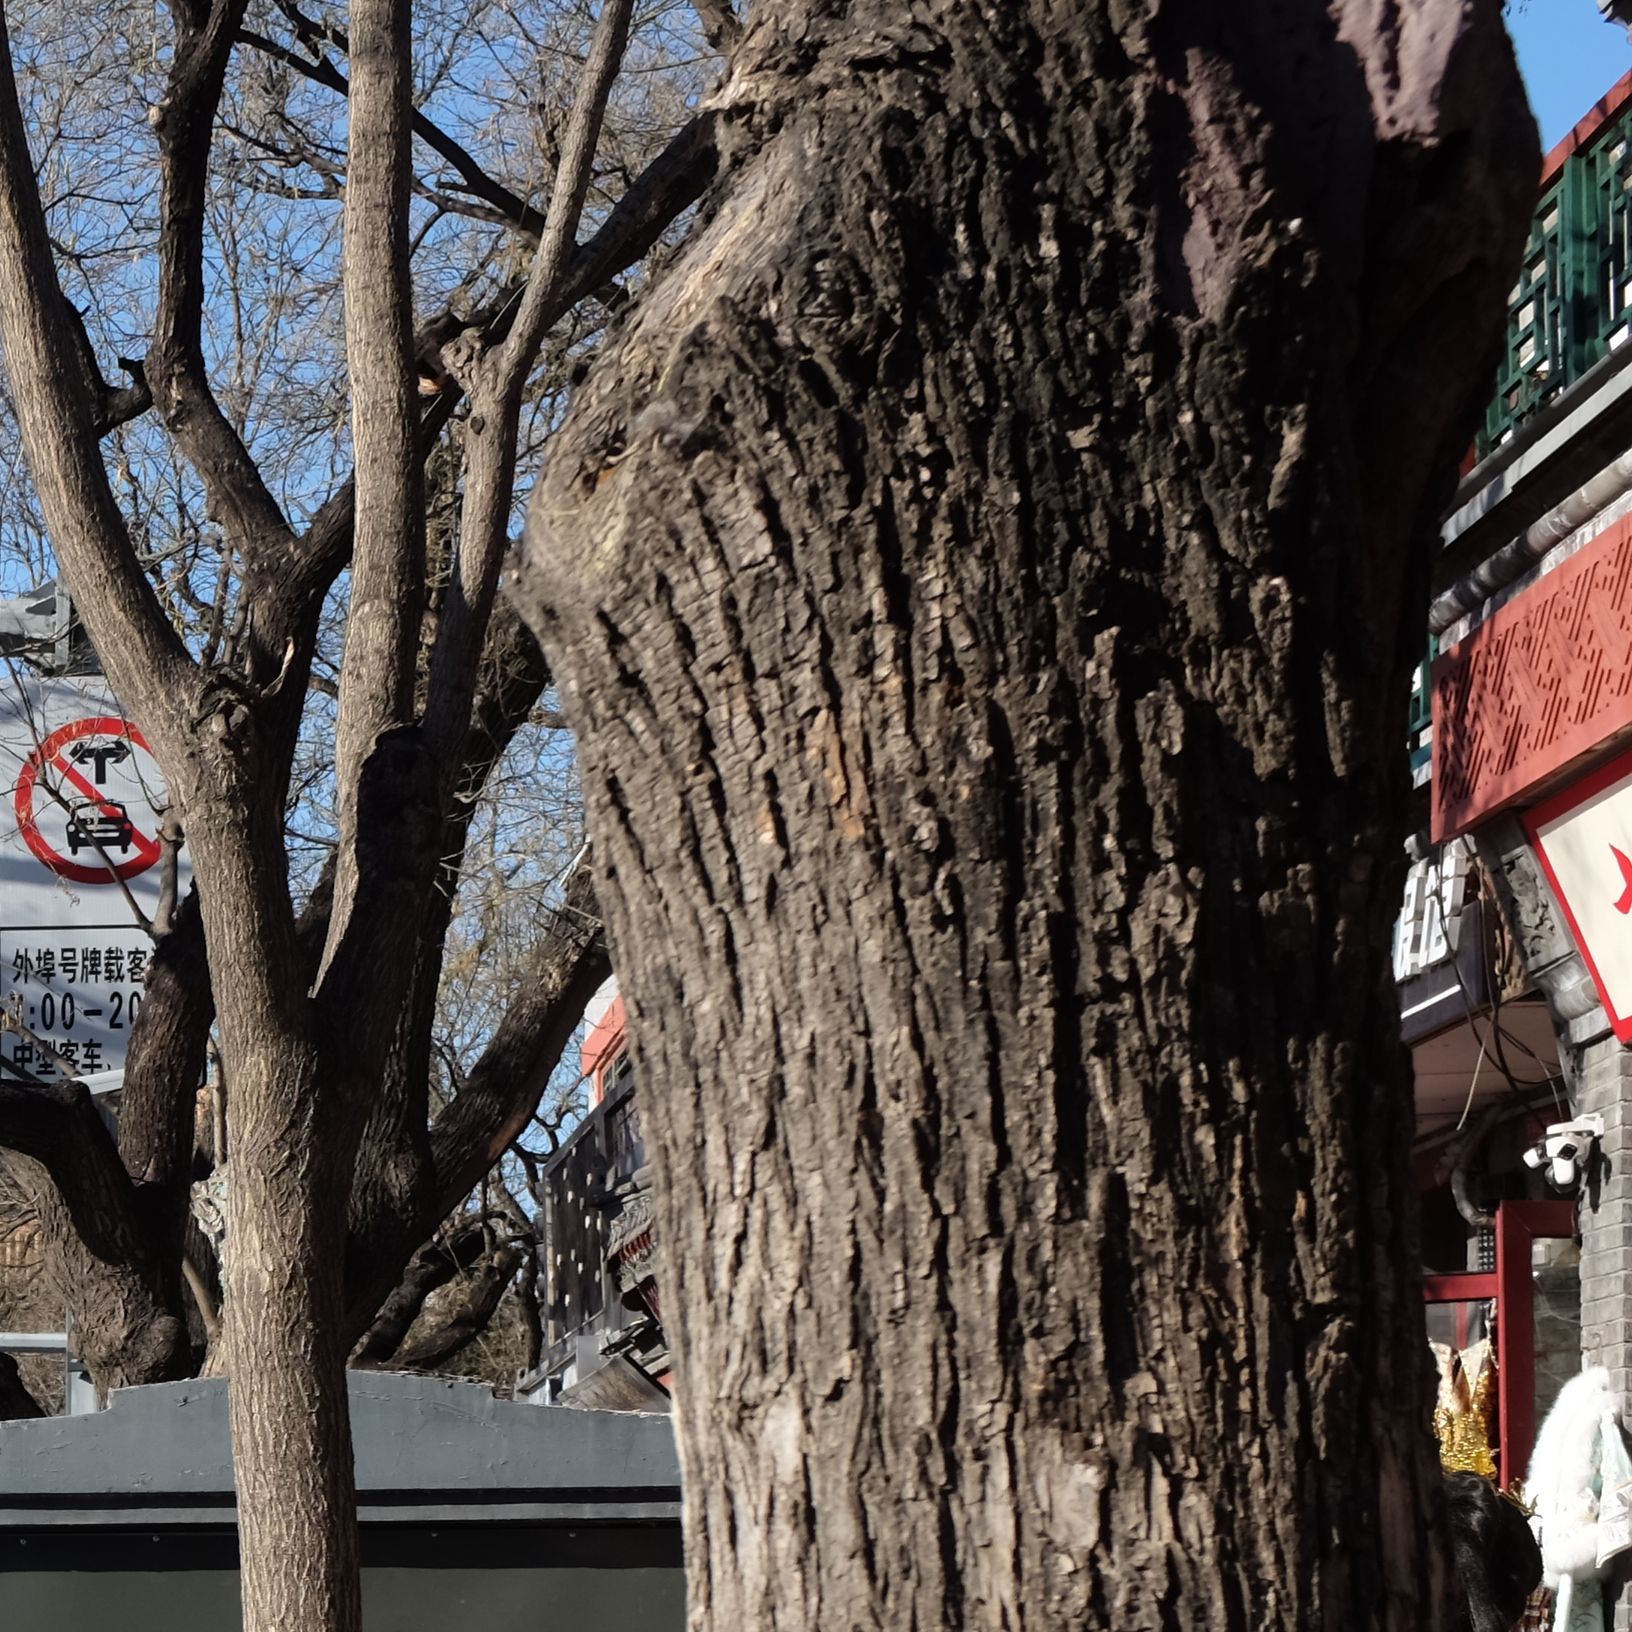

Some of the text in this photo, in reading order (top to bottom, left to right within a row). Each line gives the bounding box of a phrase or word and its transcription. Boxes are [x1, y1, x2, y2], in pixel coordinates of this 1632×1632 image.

[12, 947, 156, 984] 外埠号牌载客
